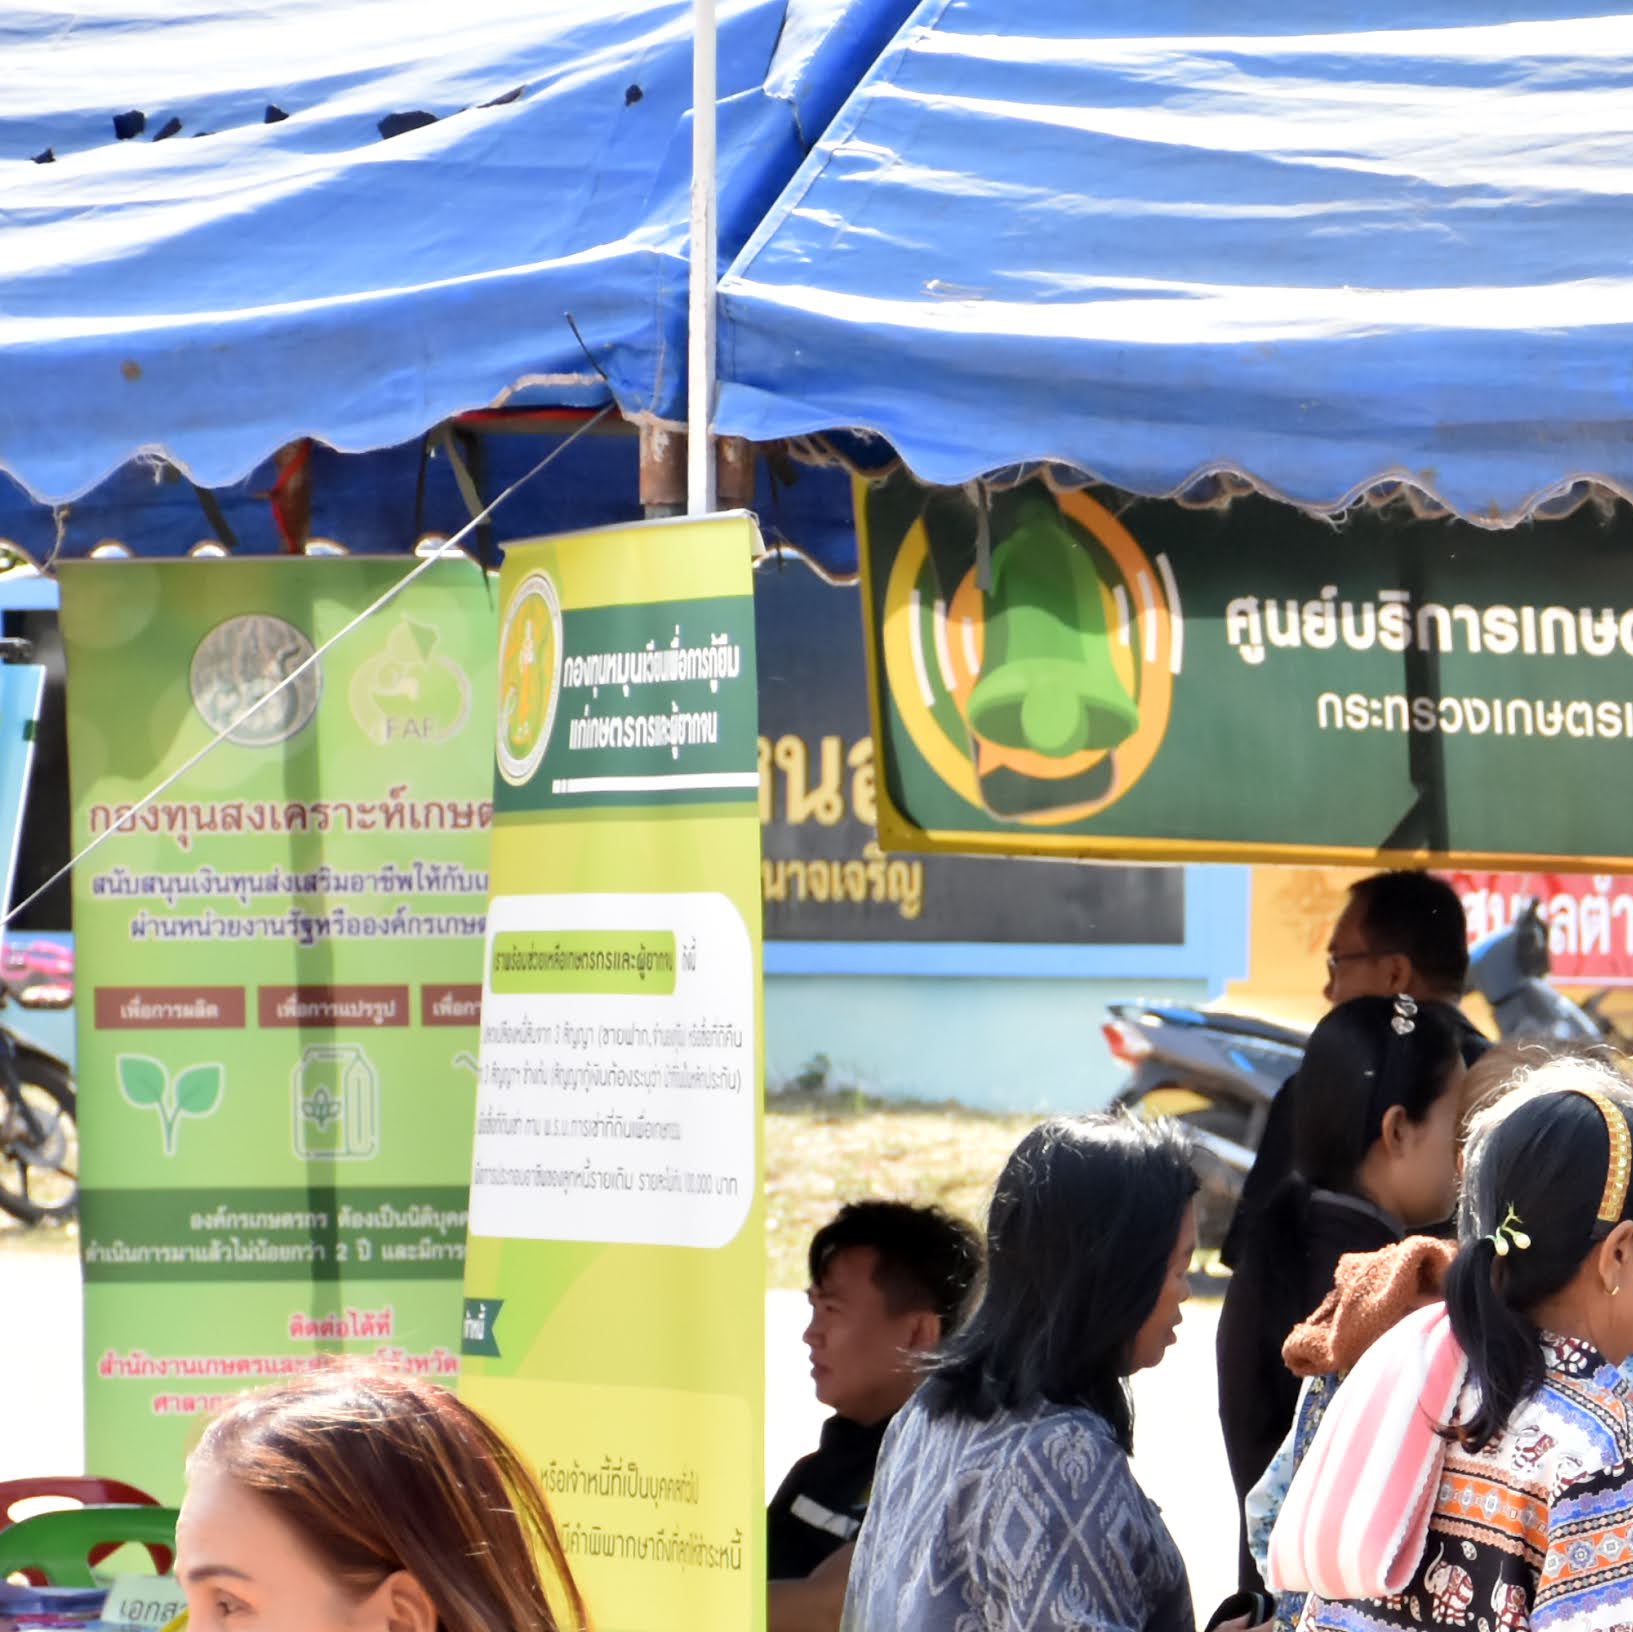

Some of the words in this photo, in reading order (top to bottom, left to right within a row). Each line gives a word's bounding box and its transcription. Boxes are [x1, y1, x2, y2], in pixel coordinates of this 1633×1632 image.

[92, 863, 489, 906] สนับสนุนเงินทุนส่งเสริมอาชีพให้กับเ
[336, 1243, 348, 1262] 2
[288, 1306, 392, 1339] ติดต่อได้ที่
